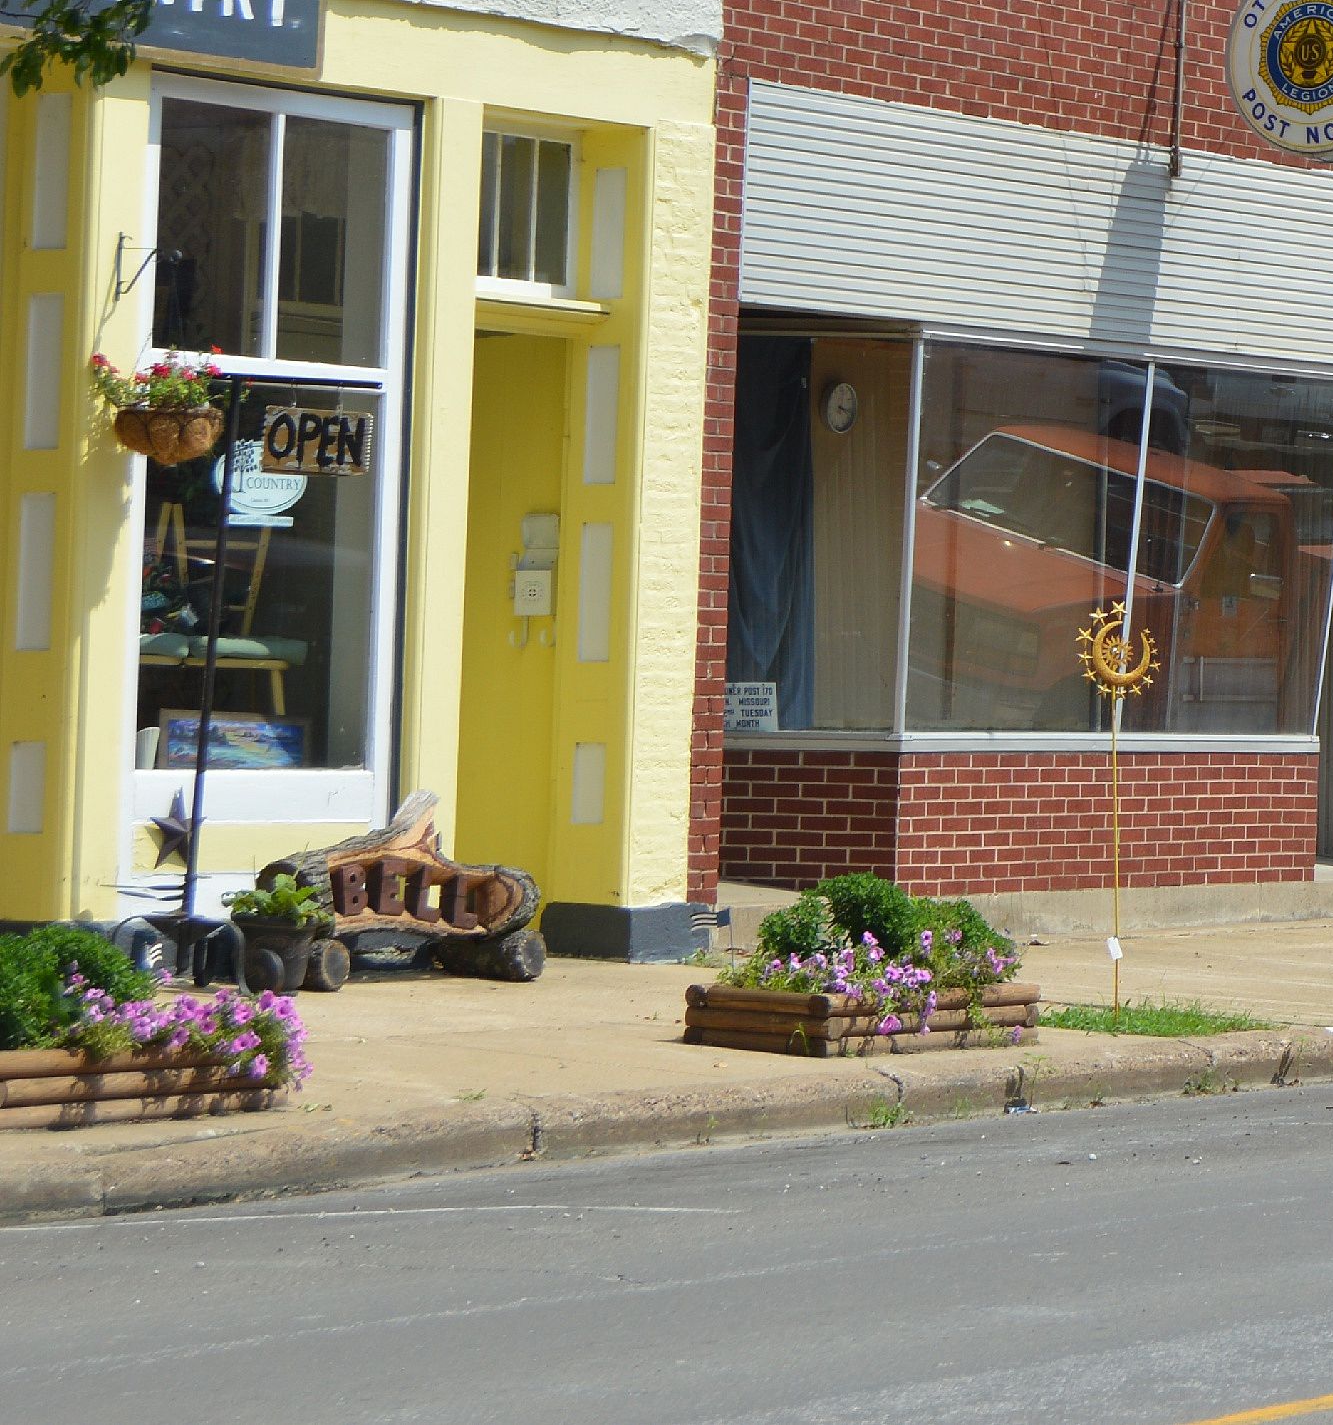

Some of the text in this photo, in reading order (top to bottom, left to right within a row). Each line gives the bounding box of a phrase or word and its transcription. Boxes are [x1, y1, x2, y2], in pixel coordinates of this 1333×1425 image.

[1242, 88, 1290, 138] POST
[267, 412, 366, 468] OPEN
[246, 476, 302, 491] COUNTRY
[744, 687, 760, 695] POST
[738, 697, 770, 705] MISSOURI
[741, 709, 773, 717] TUESDAY
[736, 719, 760, 727] MONTH
[330, 858, 479, 930] BELL
